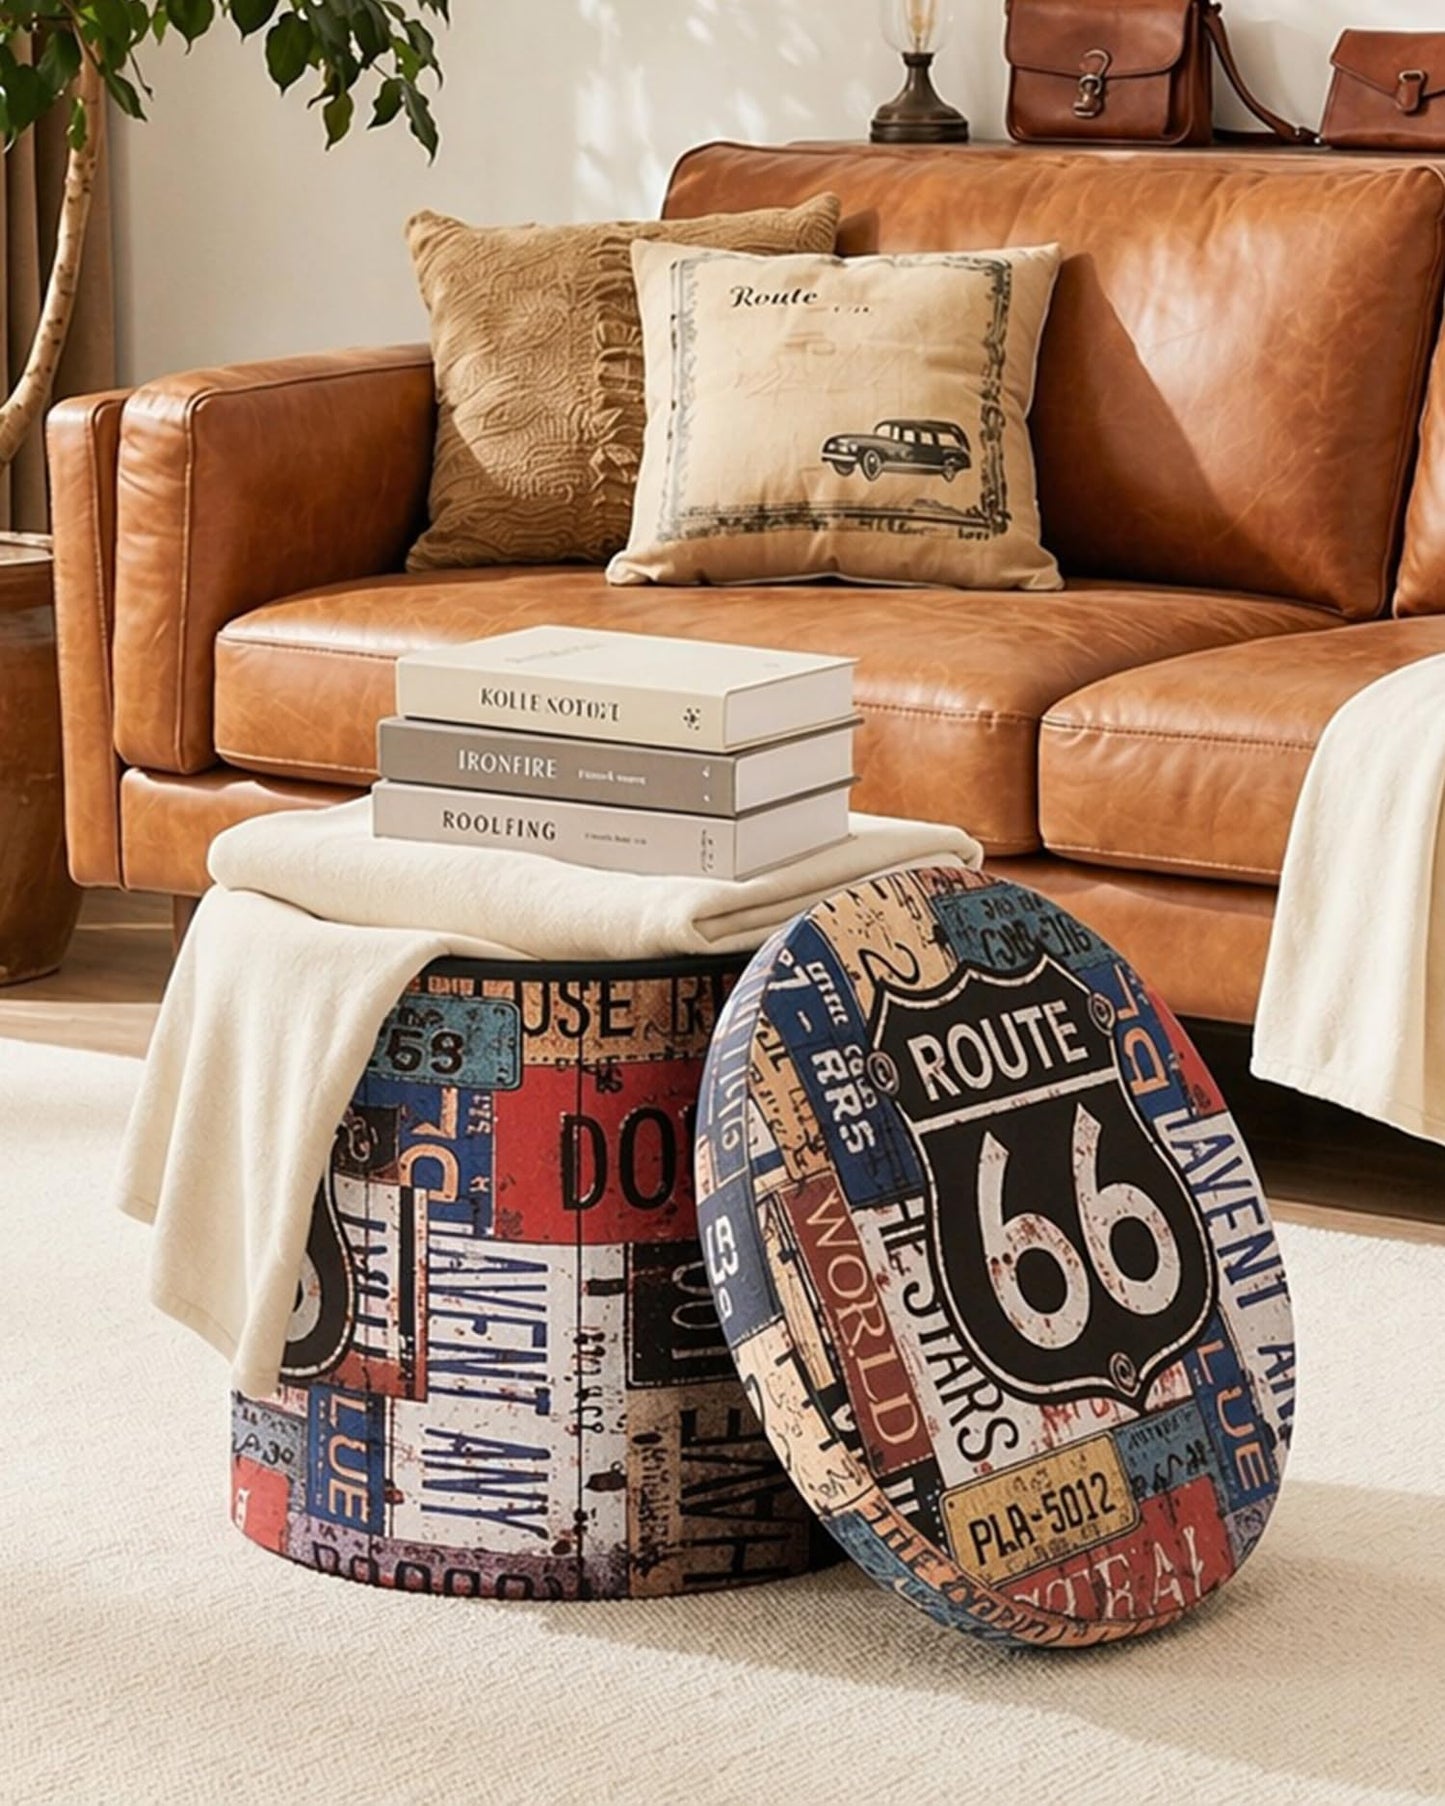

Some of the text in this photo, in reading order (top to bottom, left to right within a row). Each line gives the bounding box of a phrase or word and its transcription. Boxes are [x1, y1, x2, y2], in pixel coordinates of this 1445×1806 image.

[729, 285, 818, 308] Route
[458, 749, 558, 779] IRONFIRE
[442, 810, 557, 841] ROOLFING
[908, 999, 1090, 1101] ROUTE
[559, 1105, 697, 1212] DO
[977, 1102, 1181, 1350] 66
[806, 1188, 918, 1445] WORLD
[968, 1473, 1118, 1567] PLA-5012
